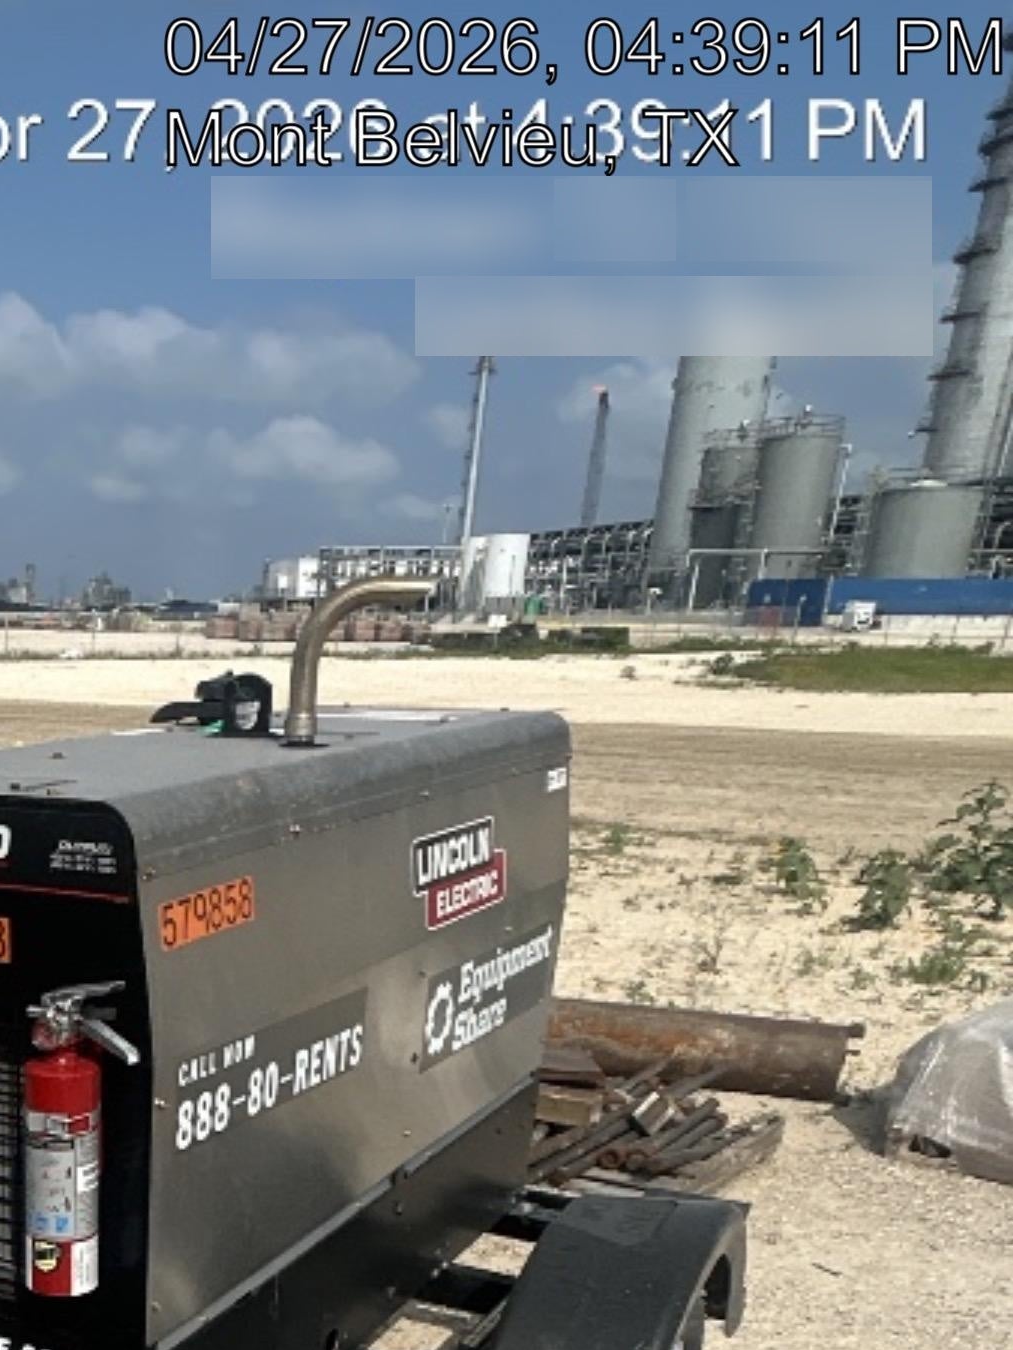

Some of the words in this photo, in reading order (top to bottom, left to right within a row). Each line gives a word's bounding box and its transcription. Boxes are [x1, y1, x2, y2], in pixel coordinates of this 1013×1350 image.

[416, 827, 492, 885] LINCOLN
[161, 877, 254, 947] 579858
[435, 869, 499, 919] ELECTRIC
[457, 926, 554, 1006] Equipment
[451, 997, 509, 1052] Share
[174, 1024, 365, 1151] 888-80-RENTS
[178, 1052, 217, 1087] CALL
[222, 1034, 256, 1068] NOW
